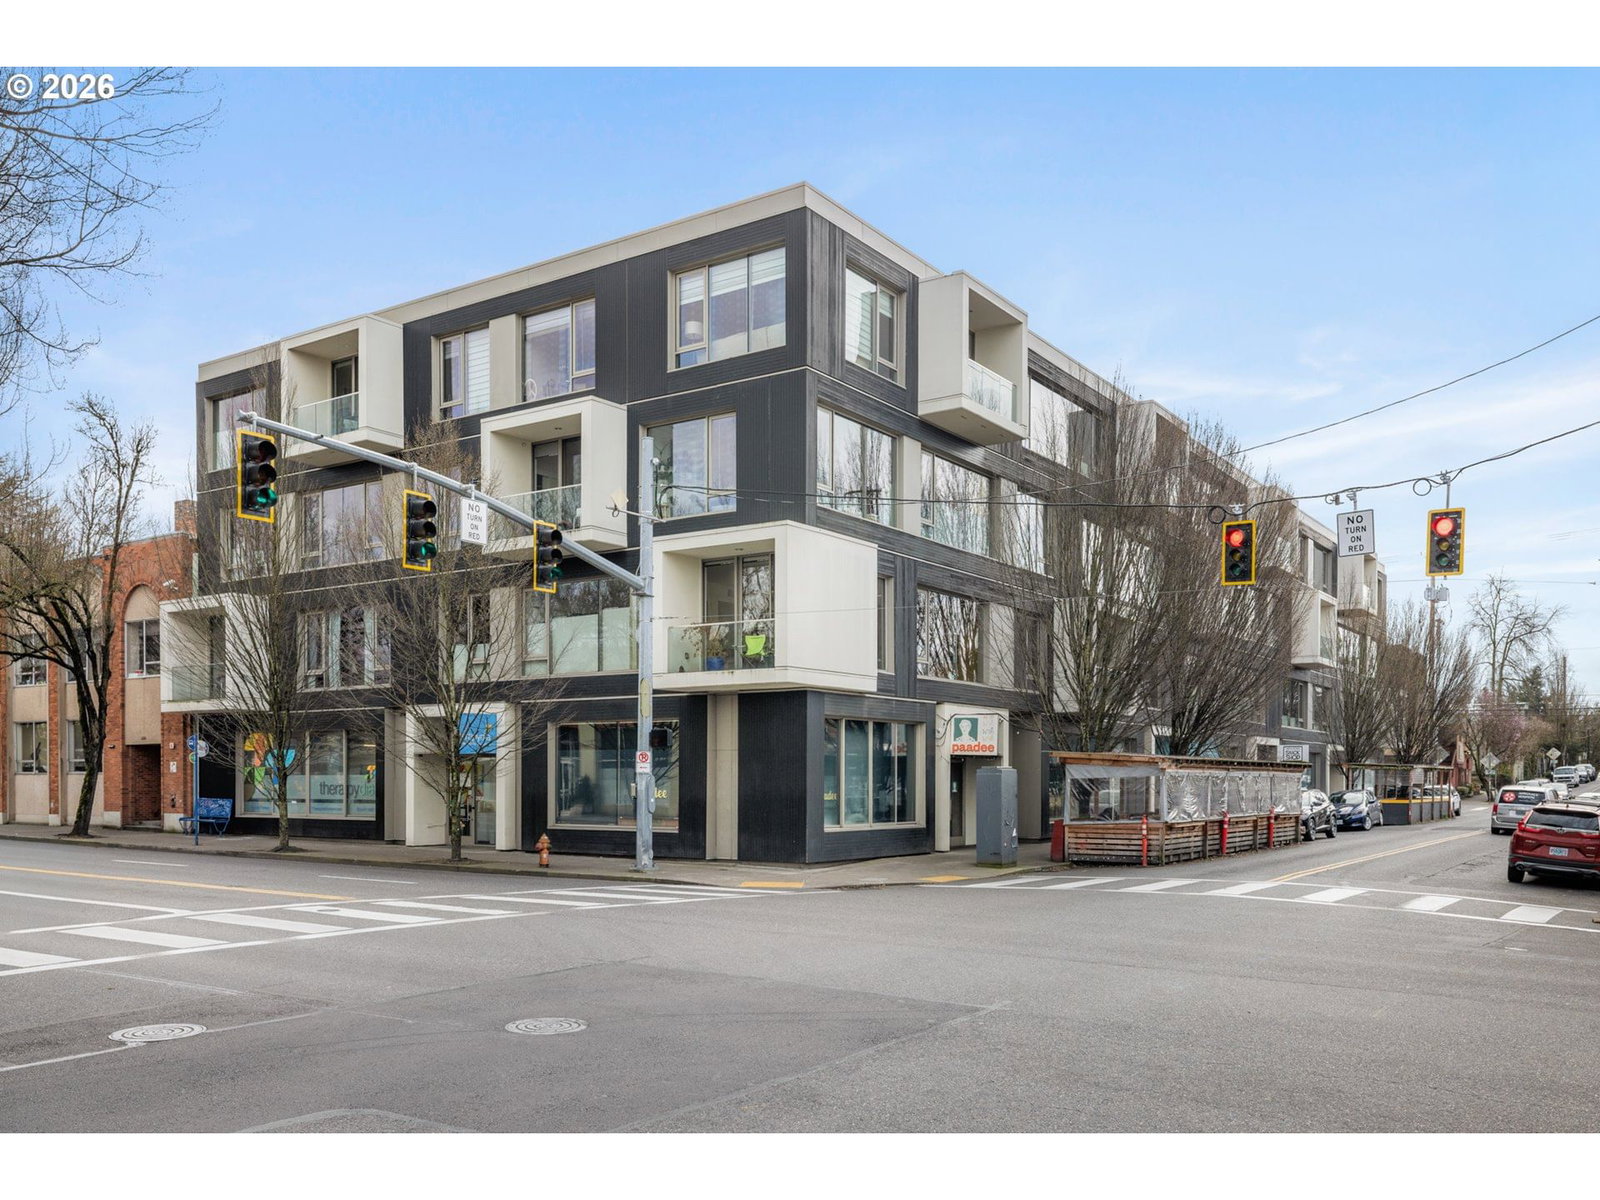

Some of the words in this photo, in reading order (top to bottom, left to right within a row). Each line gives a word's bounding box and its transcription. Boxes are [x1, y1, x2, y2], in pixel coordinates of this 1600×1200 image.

[468, 503, 480, 513] NO
[467, 513, 483, 523] TURN
[1347, 514, 1364, 525] NO
[470, 523, 479, 531] ON
[1345, 525, 1367, 535] TURN
[468, 531, 480, 540] RED
[1350, 535, 1362, 543] ON
[1348, 544, 1365, 553] RED
[952, 741, 995, 754] paadee
